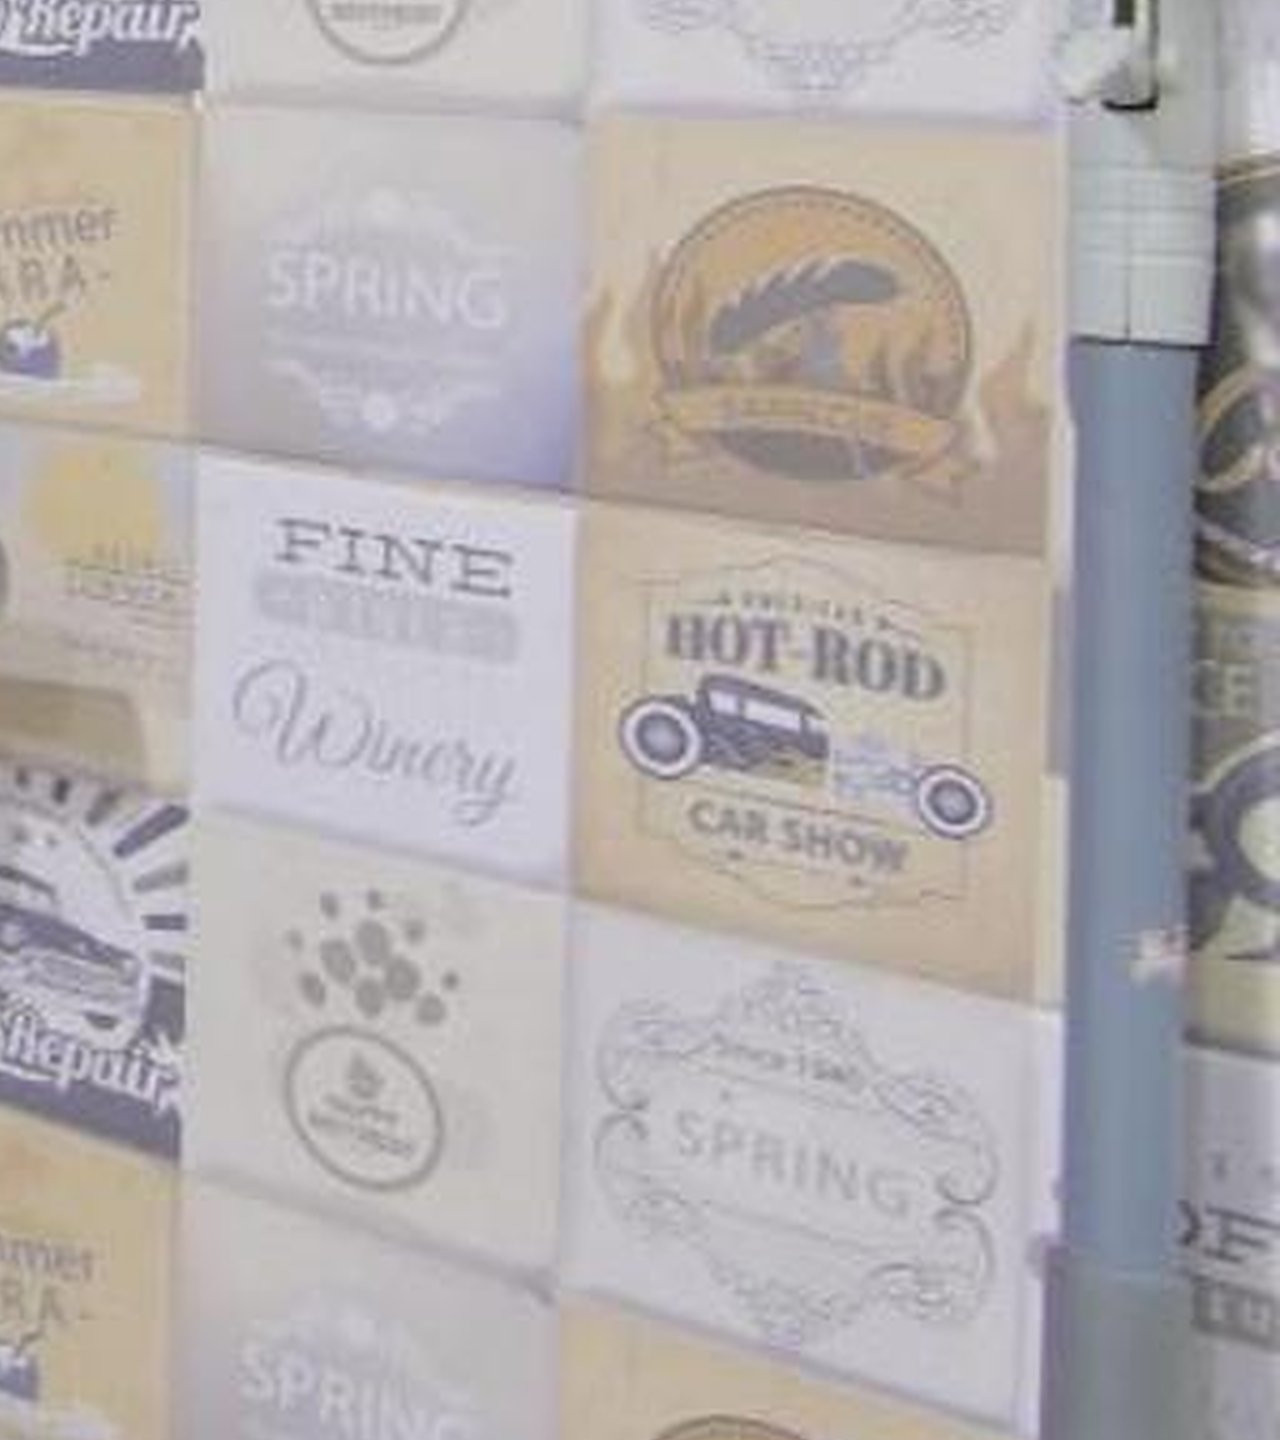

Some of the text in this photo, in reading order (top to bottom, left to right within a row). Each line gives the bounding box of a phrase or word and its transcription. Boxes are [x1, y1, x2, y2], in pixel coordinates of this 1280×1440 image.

[265, 248, 507, 330] SPRING
[273, 517, 514, 599] FINE
[231, 659, 519, 827] Winery
[688, 799, 910, 872] CAR SHOW
[675, 1108, 911, 1218] SPRING
